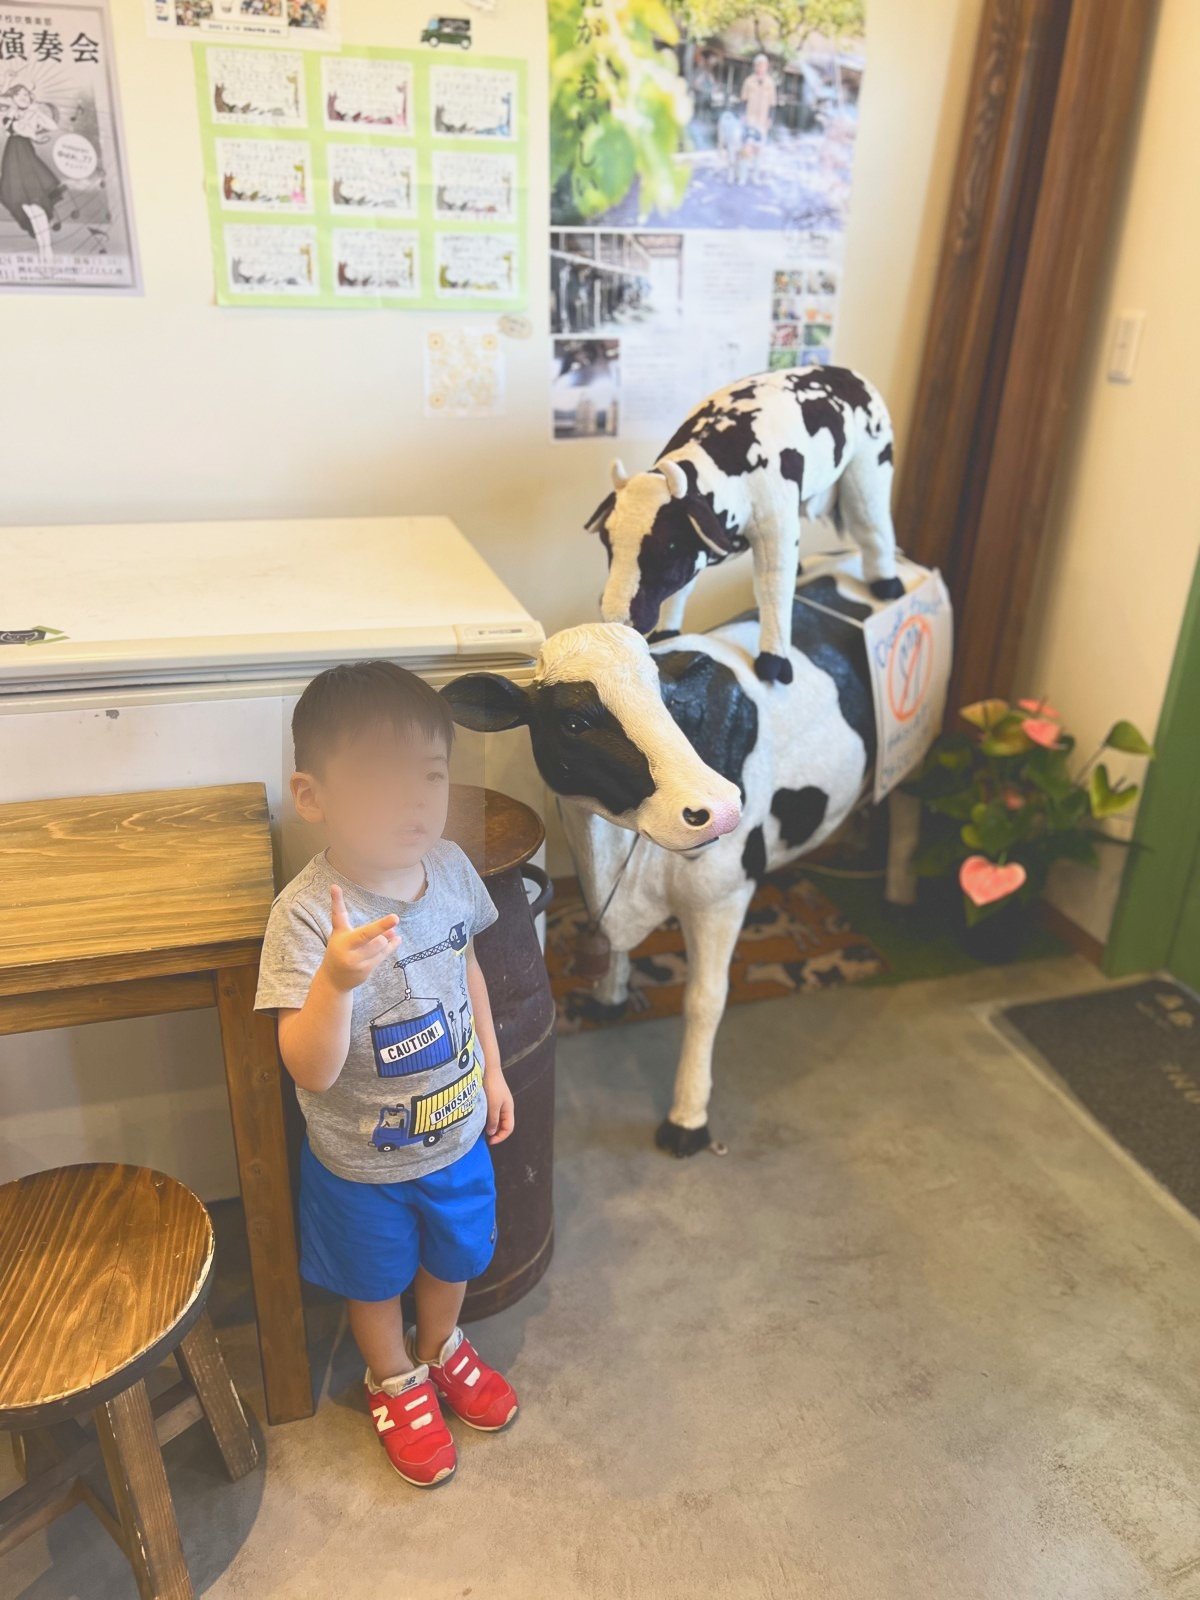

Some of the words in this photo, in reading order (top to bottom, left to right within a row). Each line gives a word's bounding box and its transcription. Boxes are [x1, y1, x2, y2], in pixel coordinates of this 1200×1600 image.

[0, 27, 99, 64] 演奏会
[387, 1027, 440, 1060] CAUTION!
[434, 1080, 477, 1122] DINOSAUR
[373, 1406, 395, 1432] N
